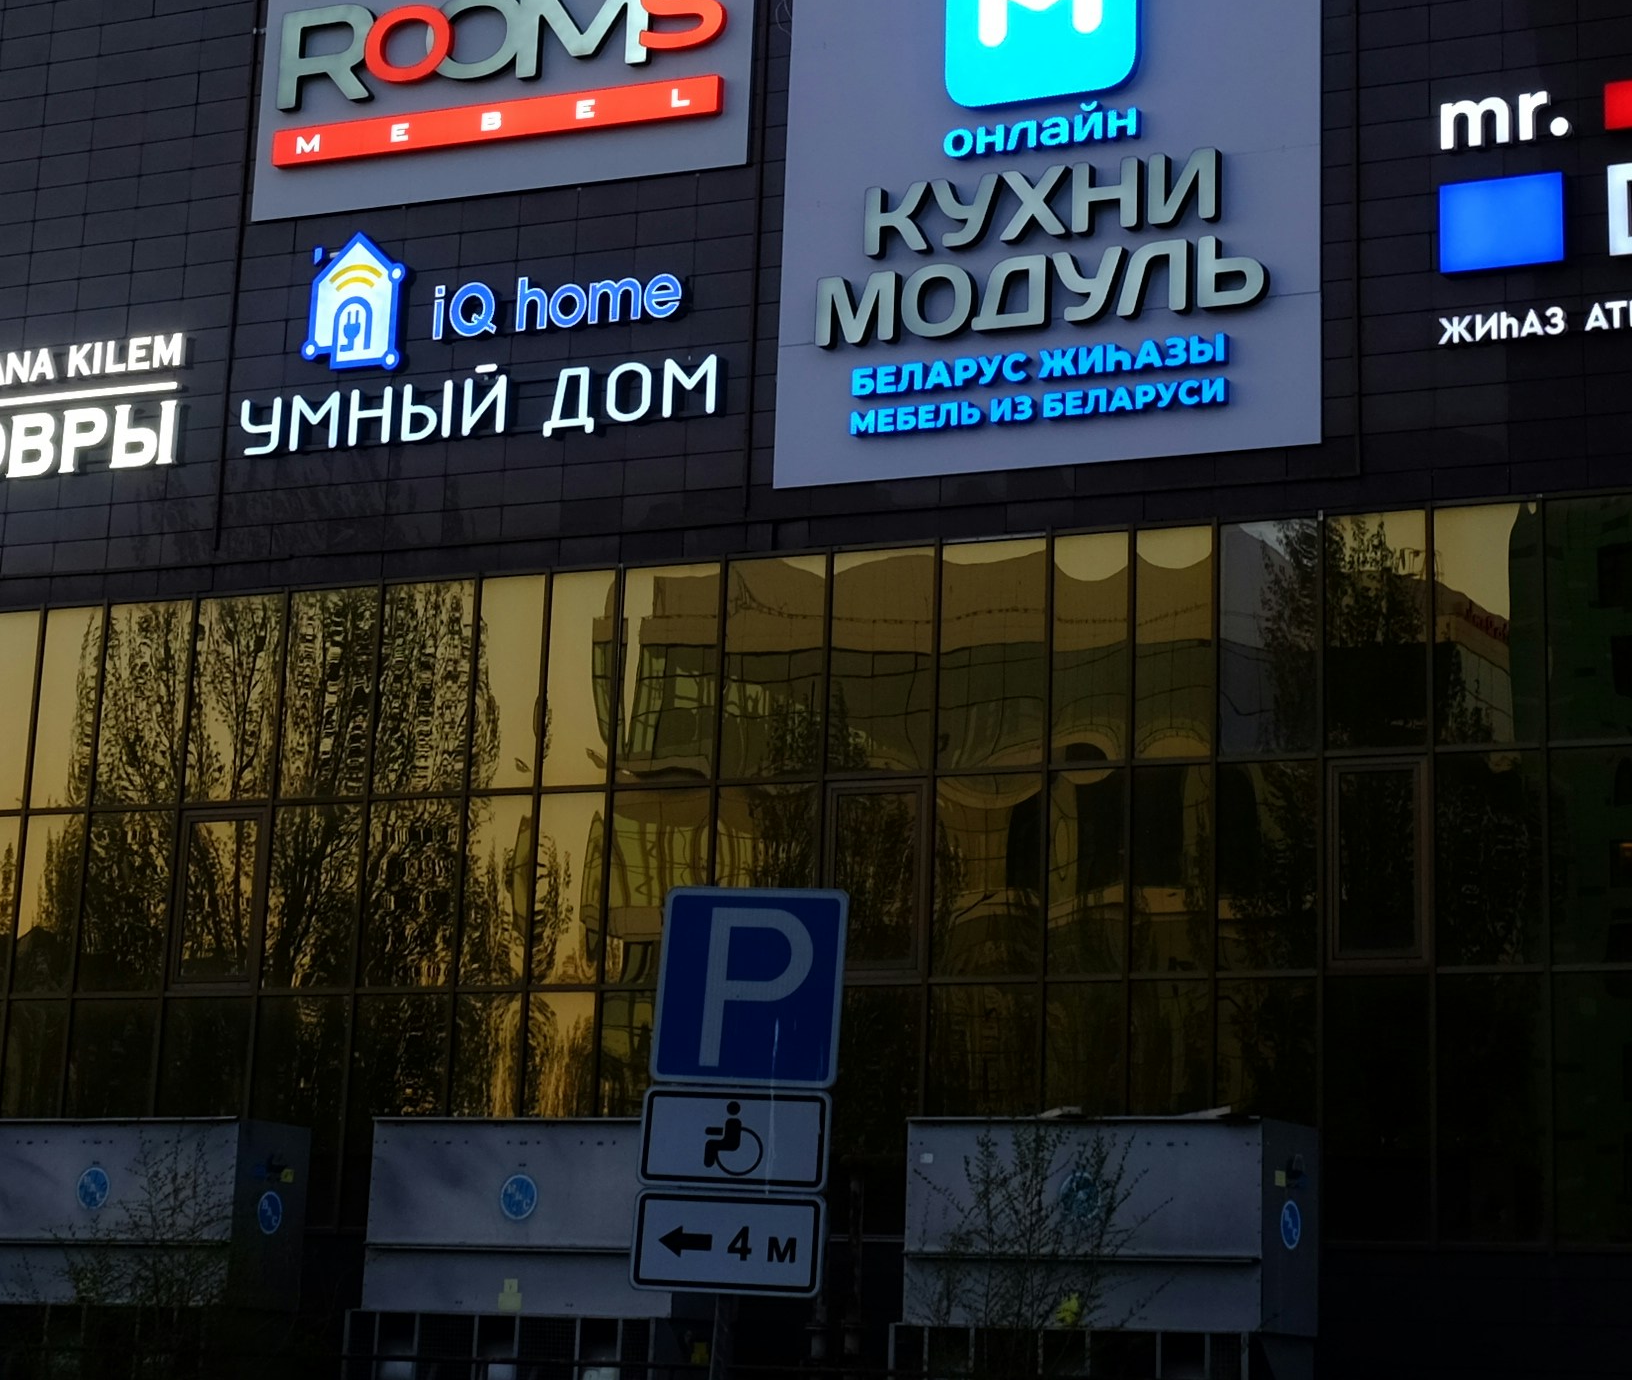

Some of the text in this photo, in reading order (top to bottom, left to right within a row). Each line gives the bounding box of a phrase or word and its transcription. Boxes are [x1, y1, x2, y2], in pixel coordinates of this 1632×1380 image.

[295, 88, 691, 155] MEBEL
[942, 100, 1140, 158] онлайн
[1439, 89, 1569, 151] mr.
[863, 147, 1222, 258] КУХНИ
[432, 272, 683, 340] iQ home
[815, 236, 1268, 348] МОДУЛЬ
[68, 332, 184, 380] KILEM
[851, 350, 1027, 398] БЕЛАРУС
[239, 353, 719, 457] УМНЫЙ ДОМ
[849, 377, 1228, 437] МЕБЕЛЬ ИЗ БЕЛАРУСИ
[698, 907, 813, 1067] P
[727, 1226, 752, 1261] 4
